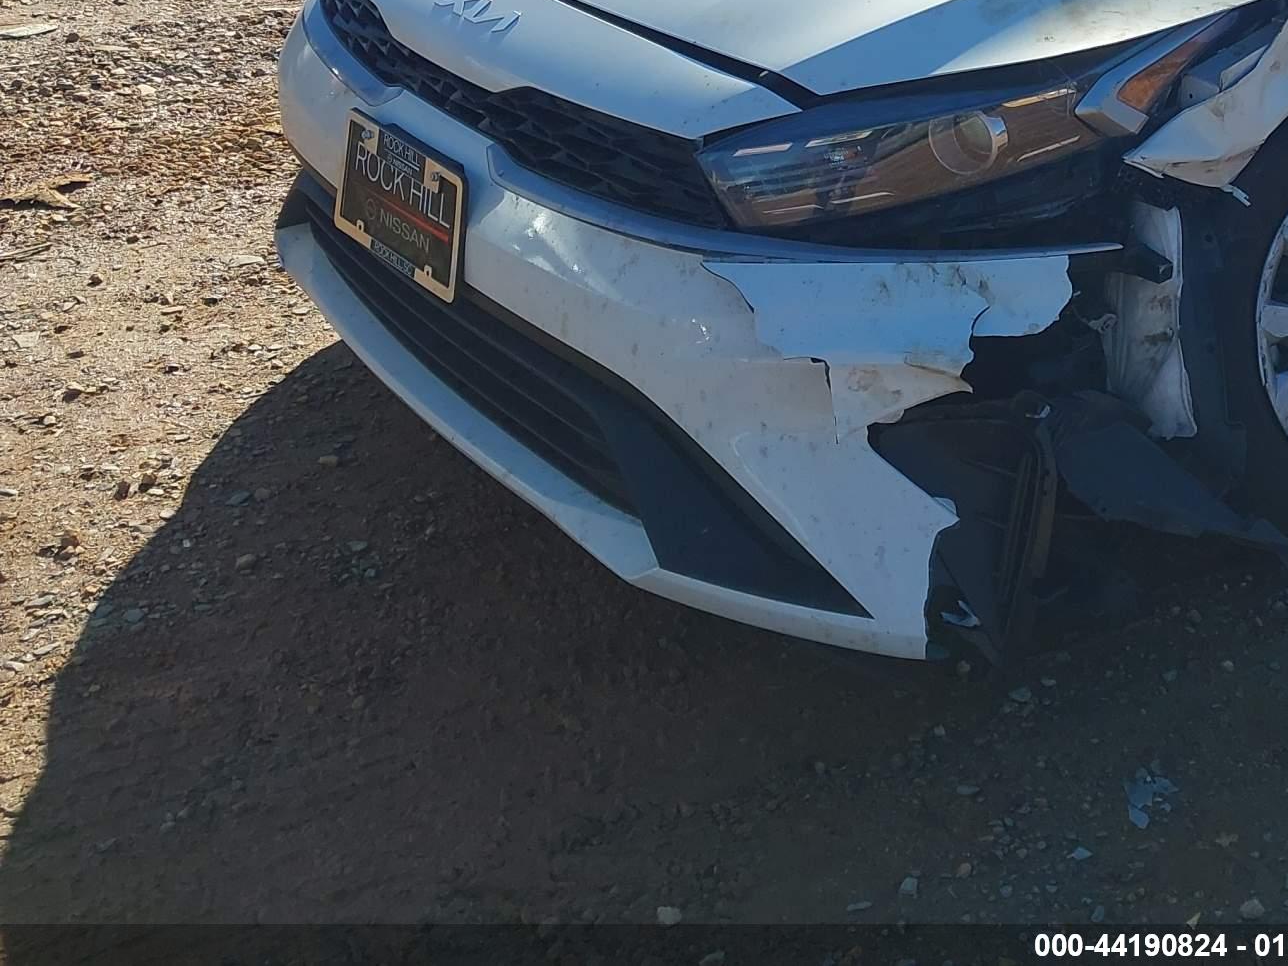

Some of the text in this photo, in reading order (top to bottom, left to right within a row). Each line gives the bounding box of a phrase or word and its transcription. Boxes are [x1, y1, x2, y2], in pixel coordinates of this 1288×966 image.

[384, 134, 420, 167] ROCK HILL
[356, 141, 450, 229] ROCK HILL
[380, 208, 430, 253] NISSAN
